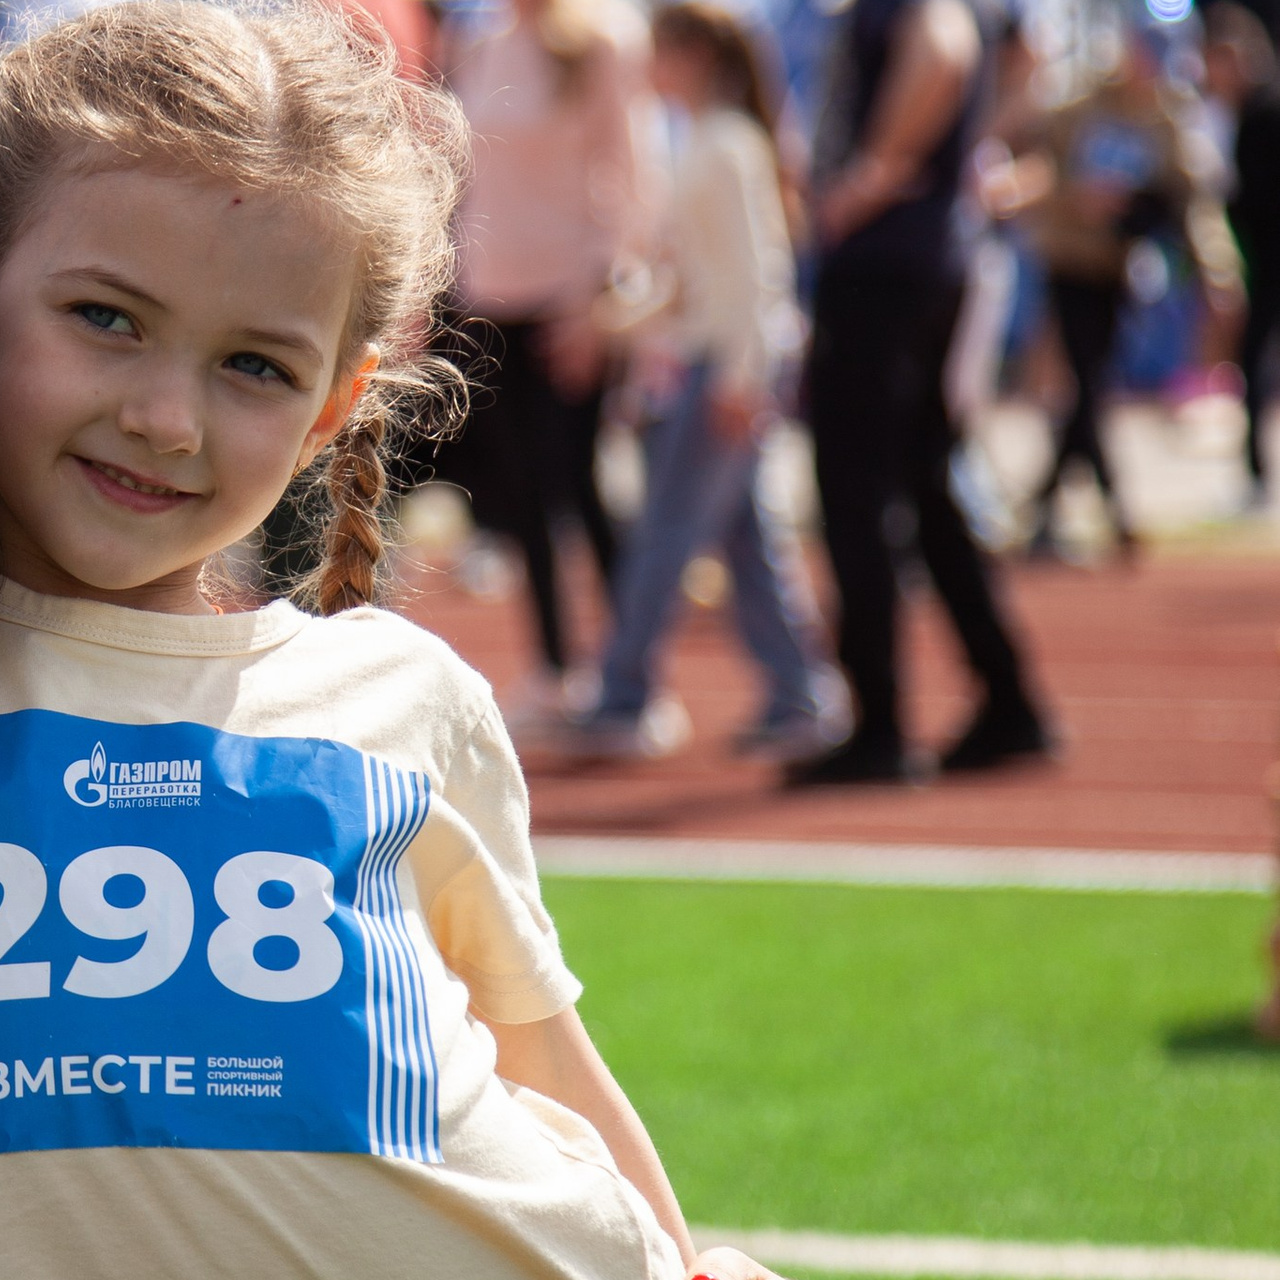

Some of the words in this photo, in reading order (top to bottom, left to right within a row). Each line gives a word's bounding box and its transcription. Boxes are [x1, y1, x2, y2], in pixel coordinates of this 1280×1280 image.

[109, 759, 202, 784] ГАЗПРОМ
[112, 784, 198, 796] ПЕРЕРАБОТКА
[108, 797, 201, 809] БЛАГОВЕЩЕНСК
[207, 1055, 284, 1070] БОЛЬШОЙ
[206, 1070, 284, 1081] СПОРТИВНЫЙ
[206, 1082, 283, 1098] ПИКНИК
